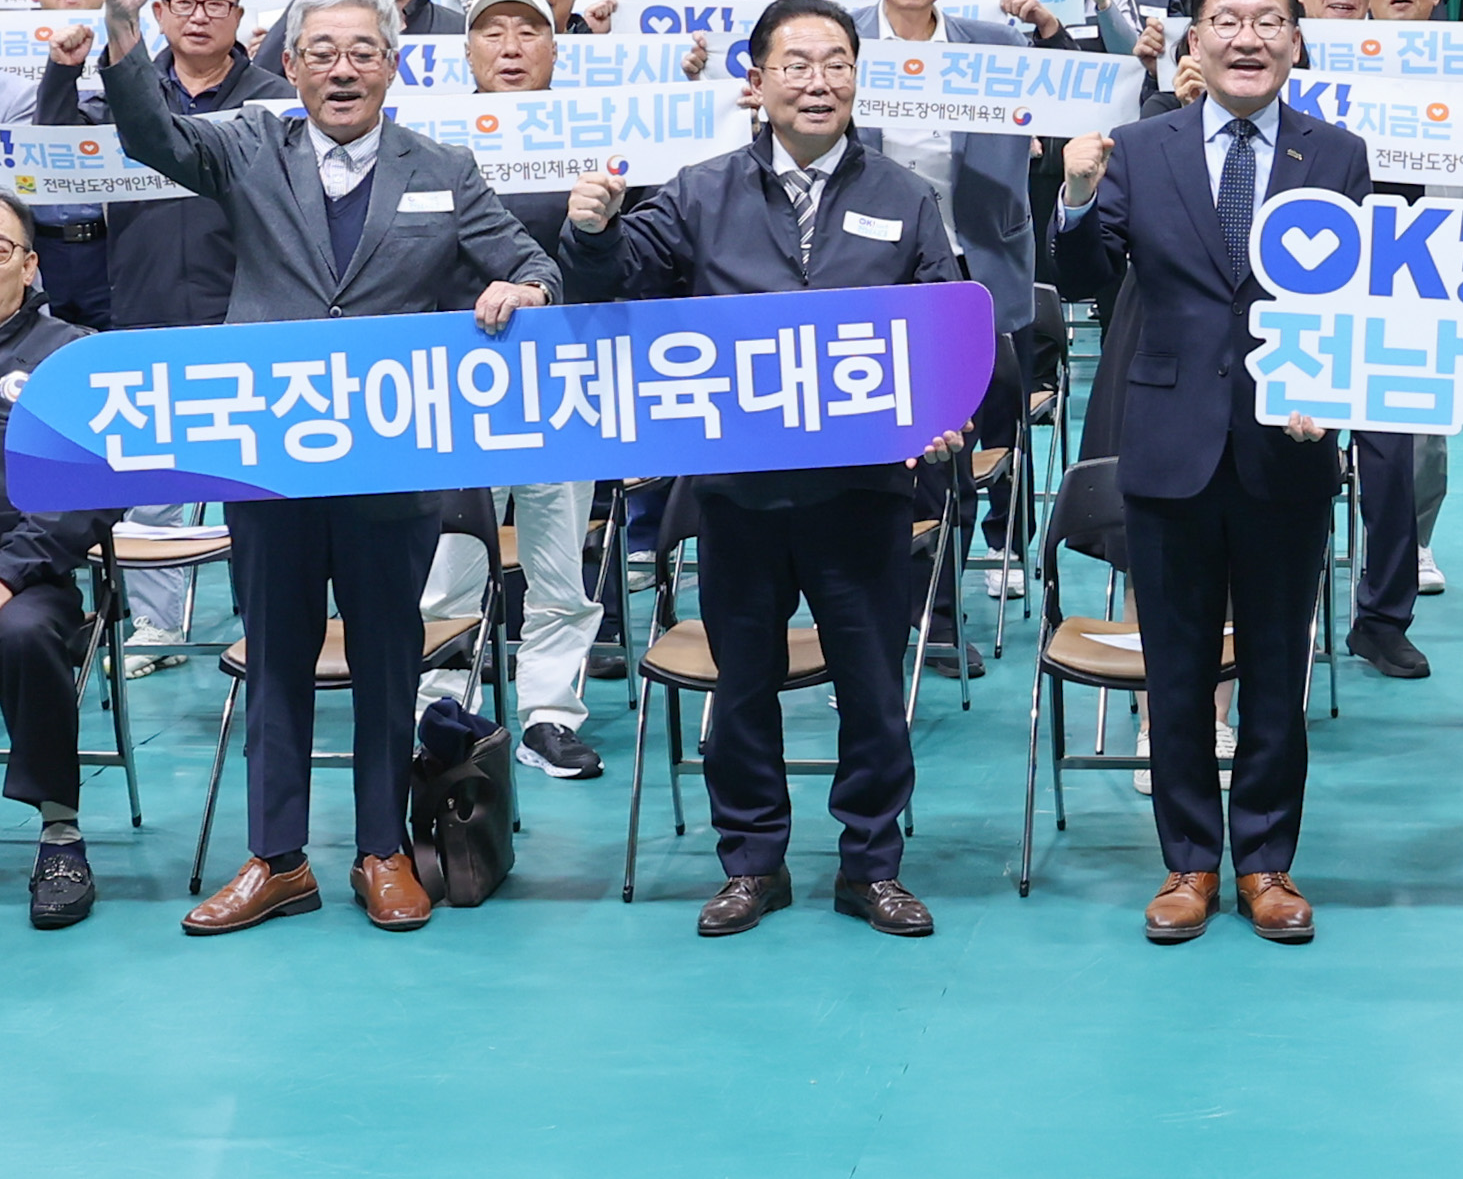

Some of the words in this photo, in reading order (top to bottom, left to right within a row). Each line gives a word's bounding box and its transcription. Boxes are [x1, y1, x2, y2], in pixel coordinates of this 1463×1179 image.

[554, 41, 692, 88] 전남시
[1309, 38, 1385, 73] 지금은
[939, 50, 1120, 105] 전남시대
[516, 89, 715, 152] 전남시대
[857, 97, 1006, 124] 전라남도장애인체육회
[1288, 77, 1352, 131] K!
[1356, 102, 1450, 139] 지금은
[19, 139, 104, 171] 지금은
[479, 157, 598, 183] 도장애인체육회
[43, 173, 176, 196] 전라남도장애인체육
[87, 316, 915, 476] 전국장애인체육대회
